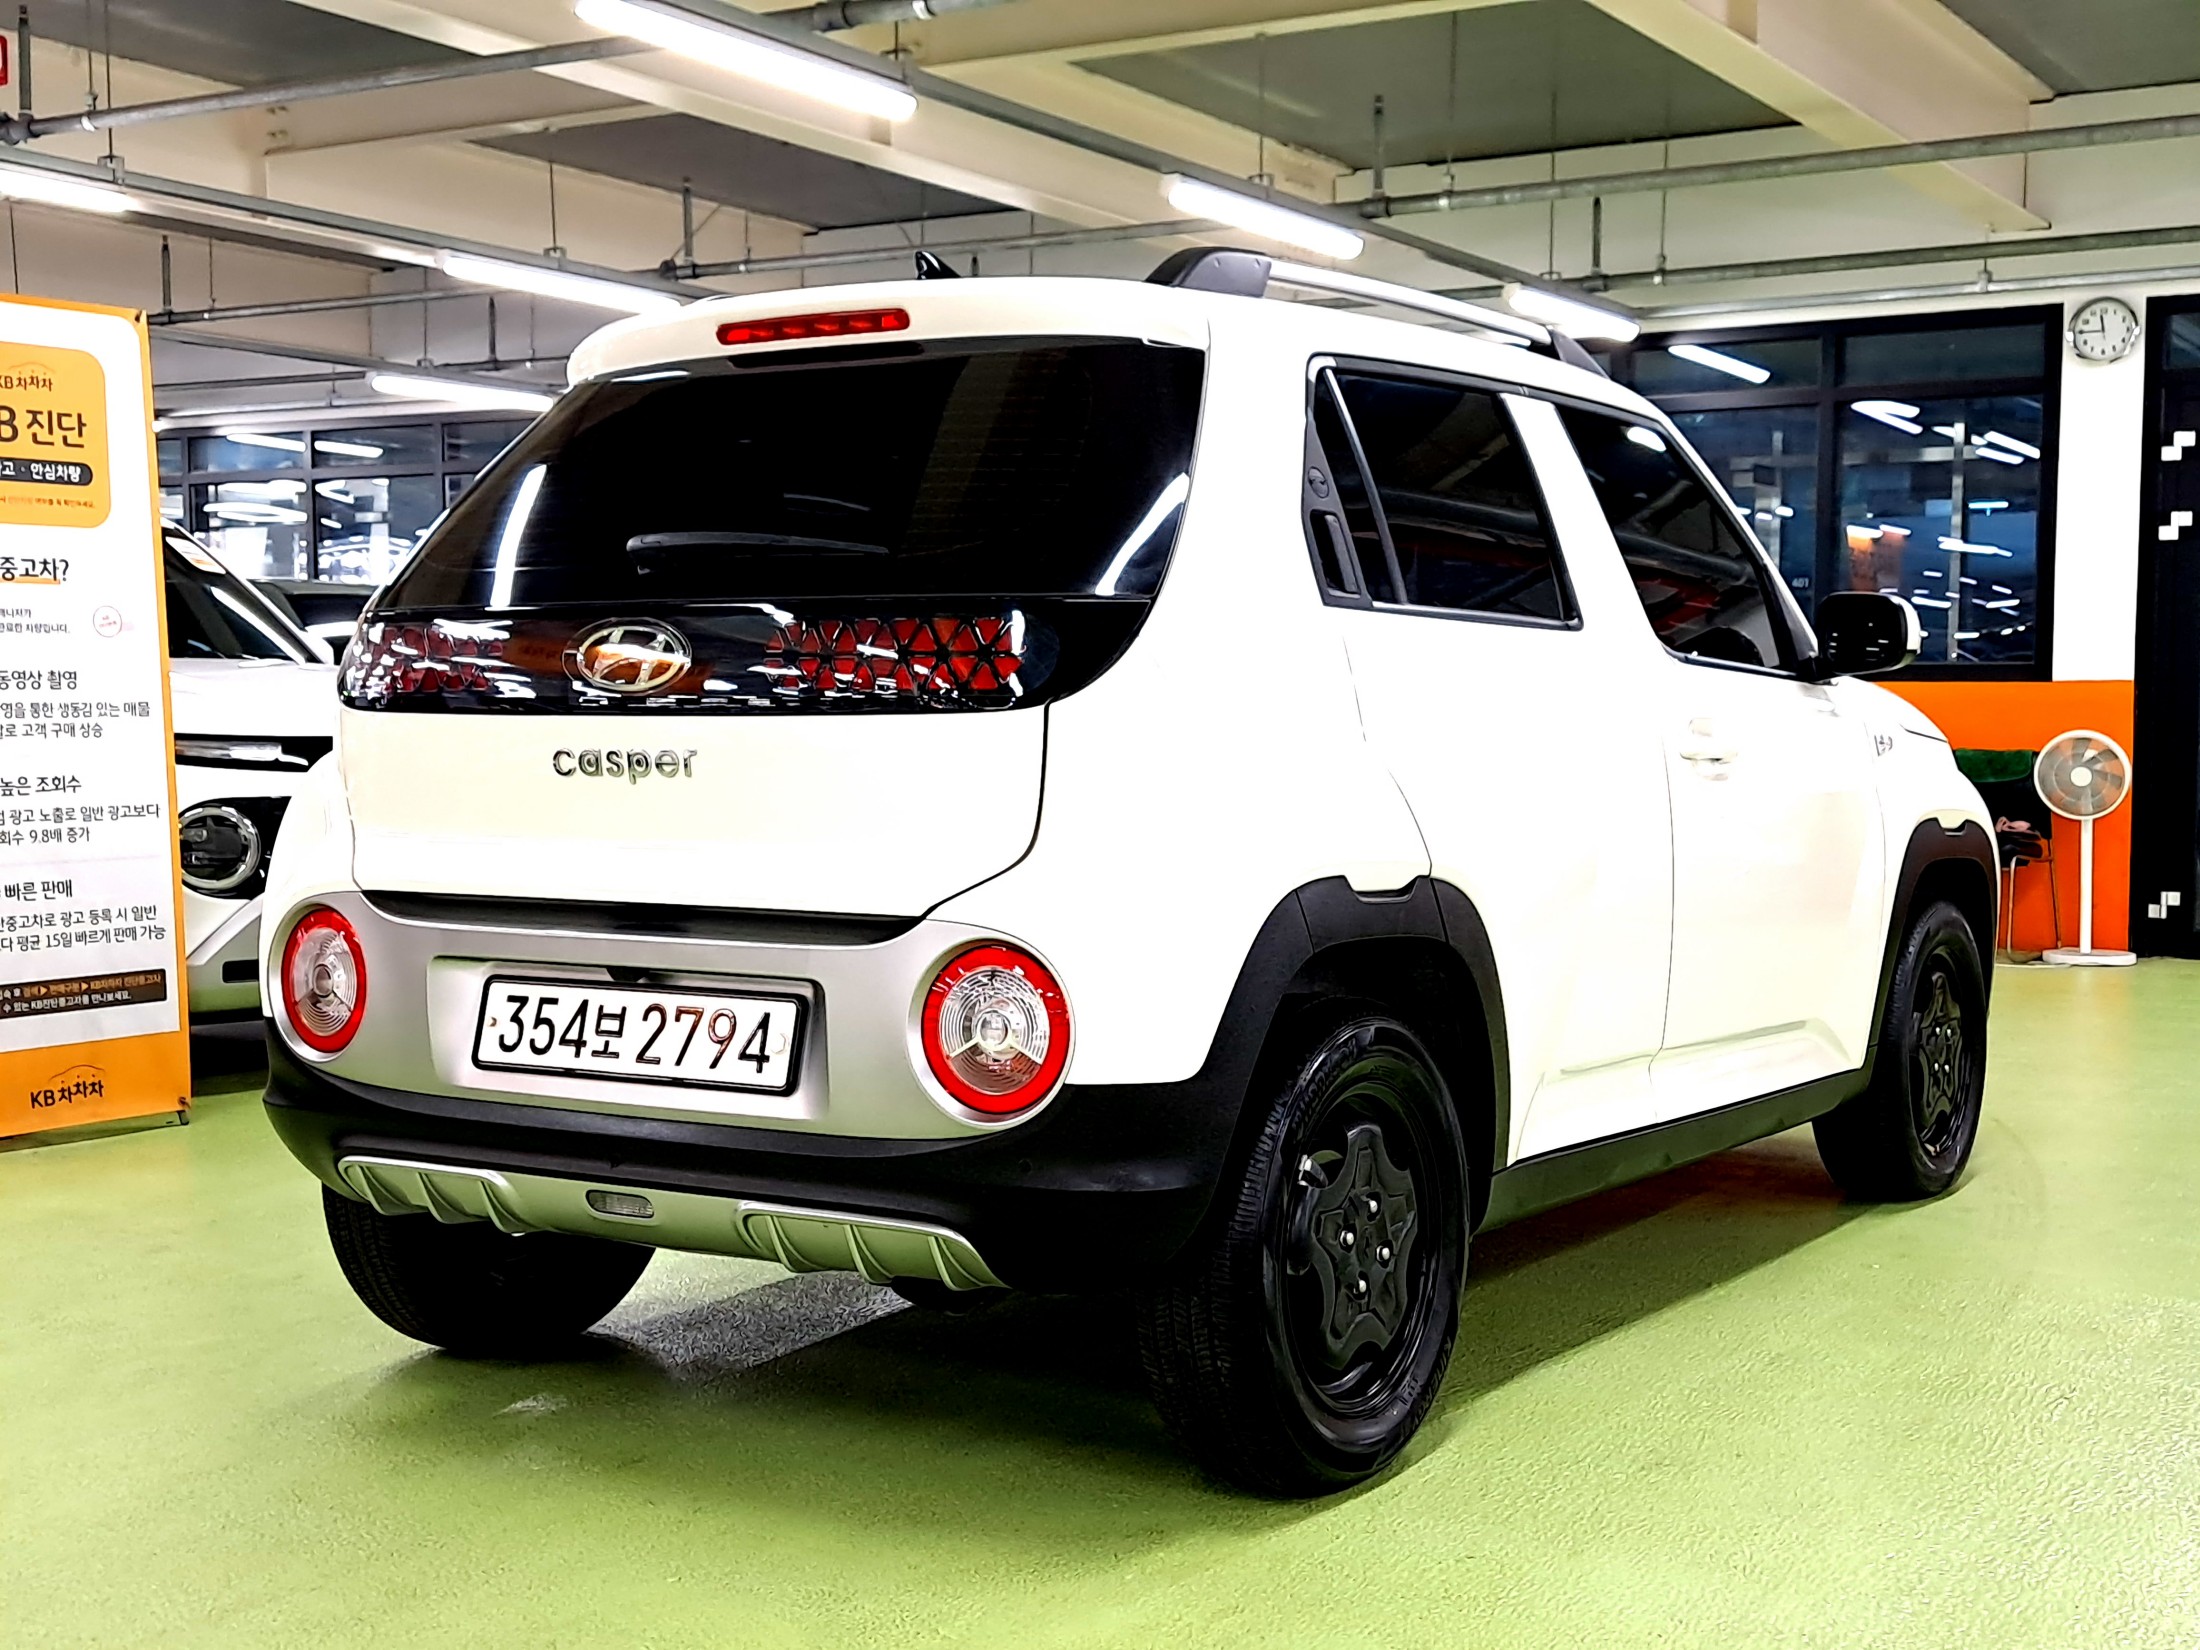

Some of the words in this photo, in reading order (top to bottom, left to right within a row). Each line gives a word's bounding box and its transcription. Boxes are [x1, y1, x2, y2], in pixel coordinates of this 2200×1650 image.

[16, 370, 54, 392] 차차차
[25, 409, 88, 449] 진단
[0, 460, 16, 478] 고
[30, 462, 82, 483] 안심차량
[0, 556, 70, 582] 중고차?
[0, 670, 43, 691] 동영상
[47, 669, 78, 691] 촬영
[30, 701, 54, 719] 통한
[96, 701, 121, 718] 있는
[123, 701, 151, 718] 매물
[0, 723, 18, 740] 로
[21, 722, 47, 740] 고객
[51, 722, 76, 738] 구매
[79, 722, 104, 739] 상승
[552, 747, 698, 785] casper
[0, 775, 32, 797] 높은
[35, 774, 82, 794] 조회수
[9, 808, 36, 826] 광고
[39, 806, 78, 824] 노출로
[80, 805, 104, 823] 일반
[107, 803, 161, 821] 광고보다
[29, 827, 62, 844] 9.8배
[66, 826, 90, 843] 증가
[4, 880, 38, 902] 빠른
[41, 878, 73, 900] 판매
[0, 912, 57, 934] 중고차로
[60, 911, 86, 929] 광고
[89, 908, 113, 926] 등록
[116, 906, 128, 922] 시
[131, 904, 157, 922] 일반
[16, 934, 42, 953] 평균
[45, 931, 73, 949] 15일
[75, 928, 111, 946] 빠르게
[113, 926, 138, 943] 판매
[140, 923, 167, 941] 가능
[498, 994, 628, 1060] 354보
[635, 1002, 772, 1074] 2794
[30, 1089, 56, 1110] KB
[57, 1073, 105, 1104] 차차차
